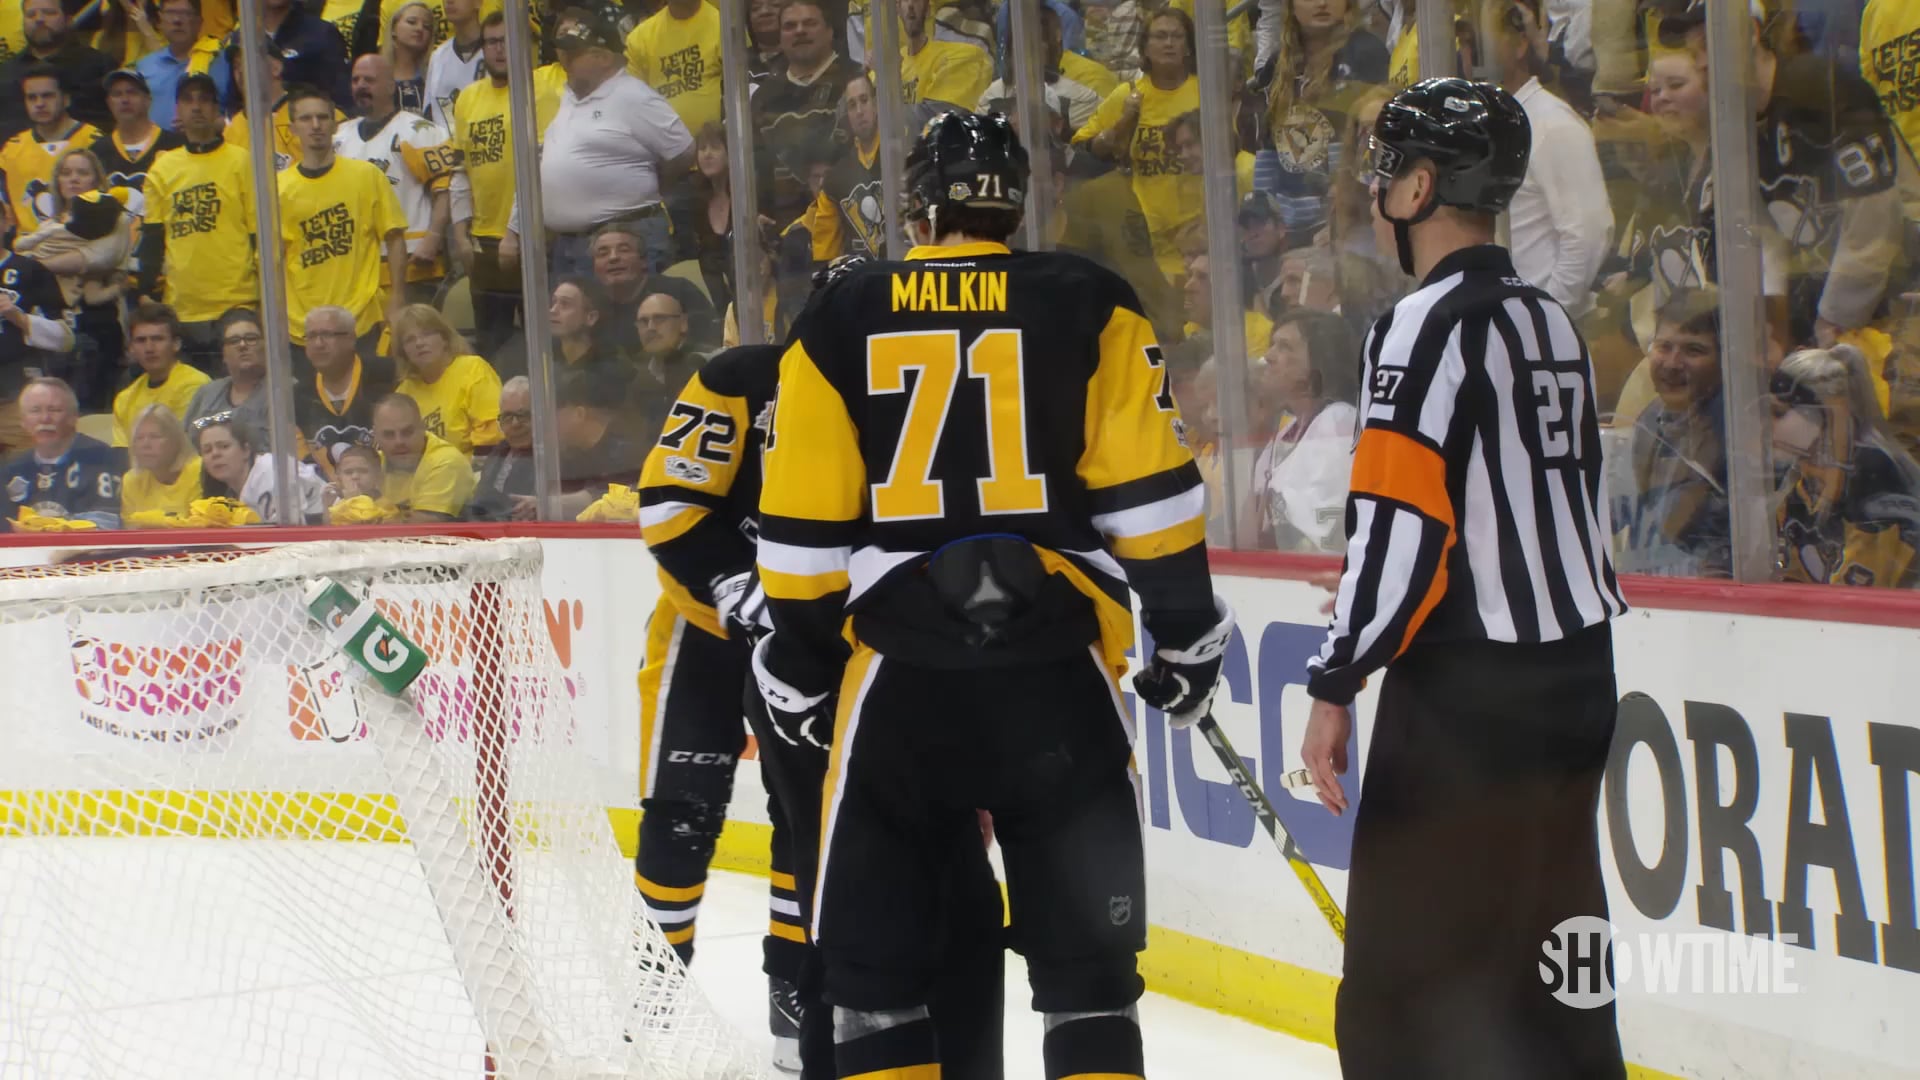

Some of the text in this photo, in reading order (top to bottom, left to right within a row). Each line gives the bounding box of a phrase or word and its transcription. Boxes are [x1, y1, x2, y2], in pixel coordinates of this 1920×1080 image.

[172, 182, 217, 208] LET'S
[976, 173, 1003, 199] 71
[170, 214, 217, 240] PENS!
[299, 202, 349, 236] LET'S
[301, 236, 353, 270] PENS!
[891, 271, 1008, 313] MALKIN
[1374, 369, 1405, 400] 27
[658, 400, 737, 464] 72
[867, 328, 1049, 522] 71
[1532, 369, 1586, 460] 27
[362, 623, 410, 674] G
[1229, 766, 1271, 817] CCM
